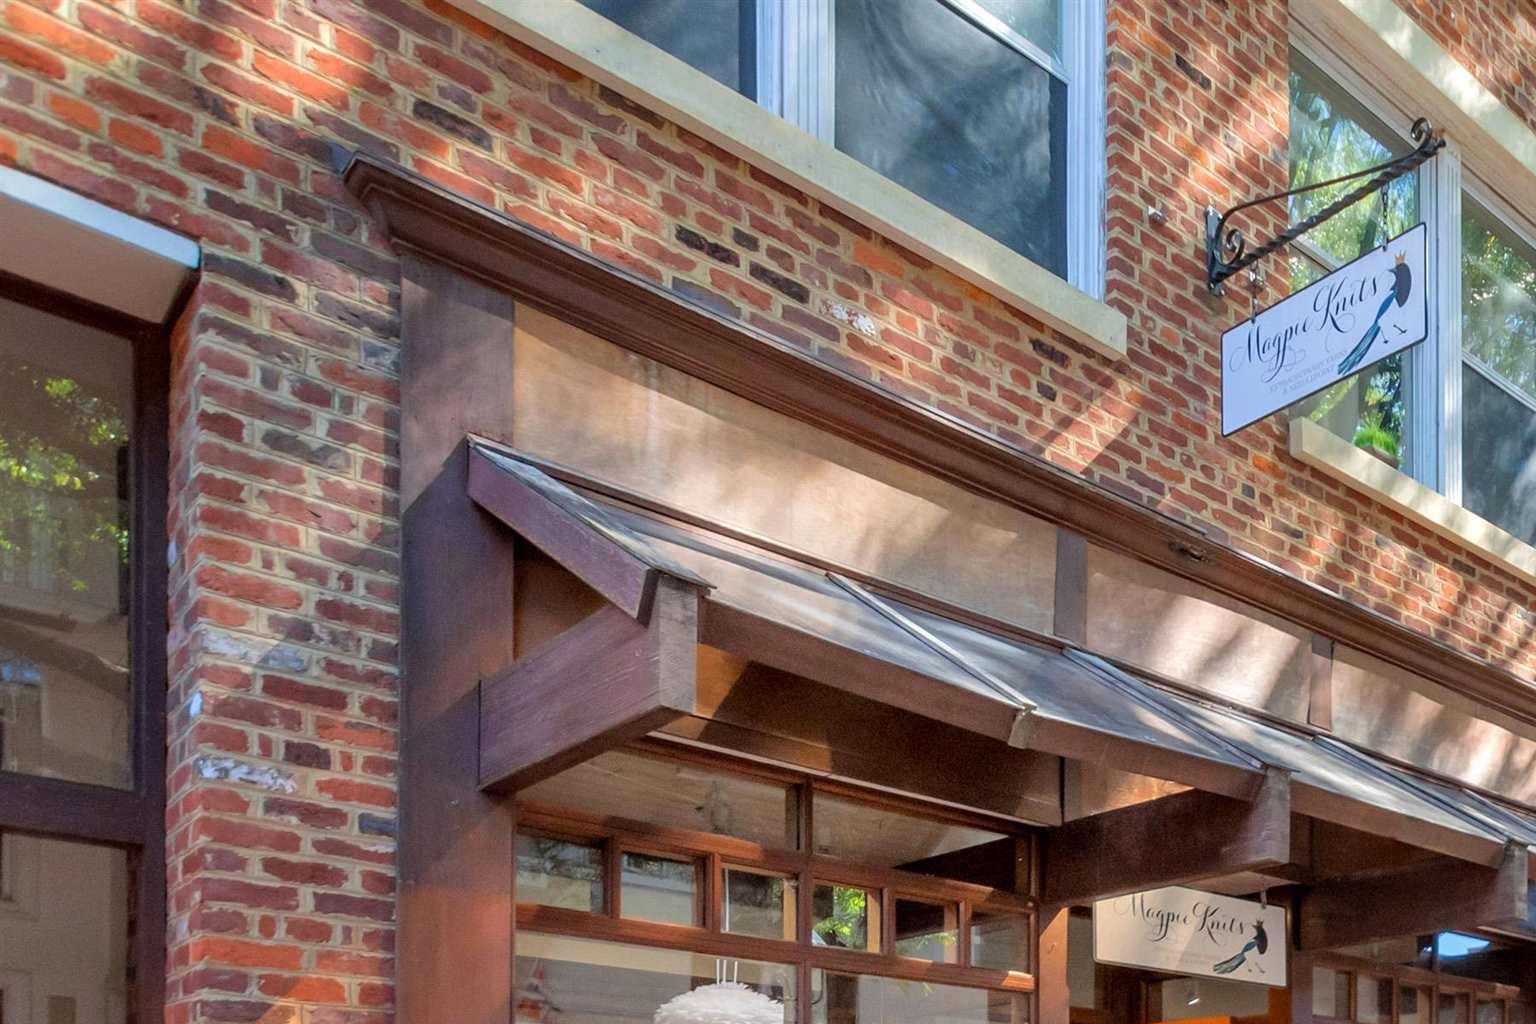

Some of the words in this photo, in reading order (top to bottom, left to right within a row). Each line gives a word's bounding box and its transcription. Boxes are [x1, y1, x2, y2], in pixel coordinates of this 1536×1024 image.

[1229, 317, 1313, 383] Magpie
[1313, 276, 1379, 334] Knits
[1113, 893, 1189, 942] Magpie
[1192, 902, 1245, 945] Knits
